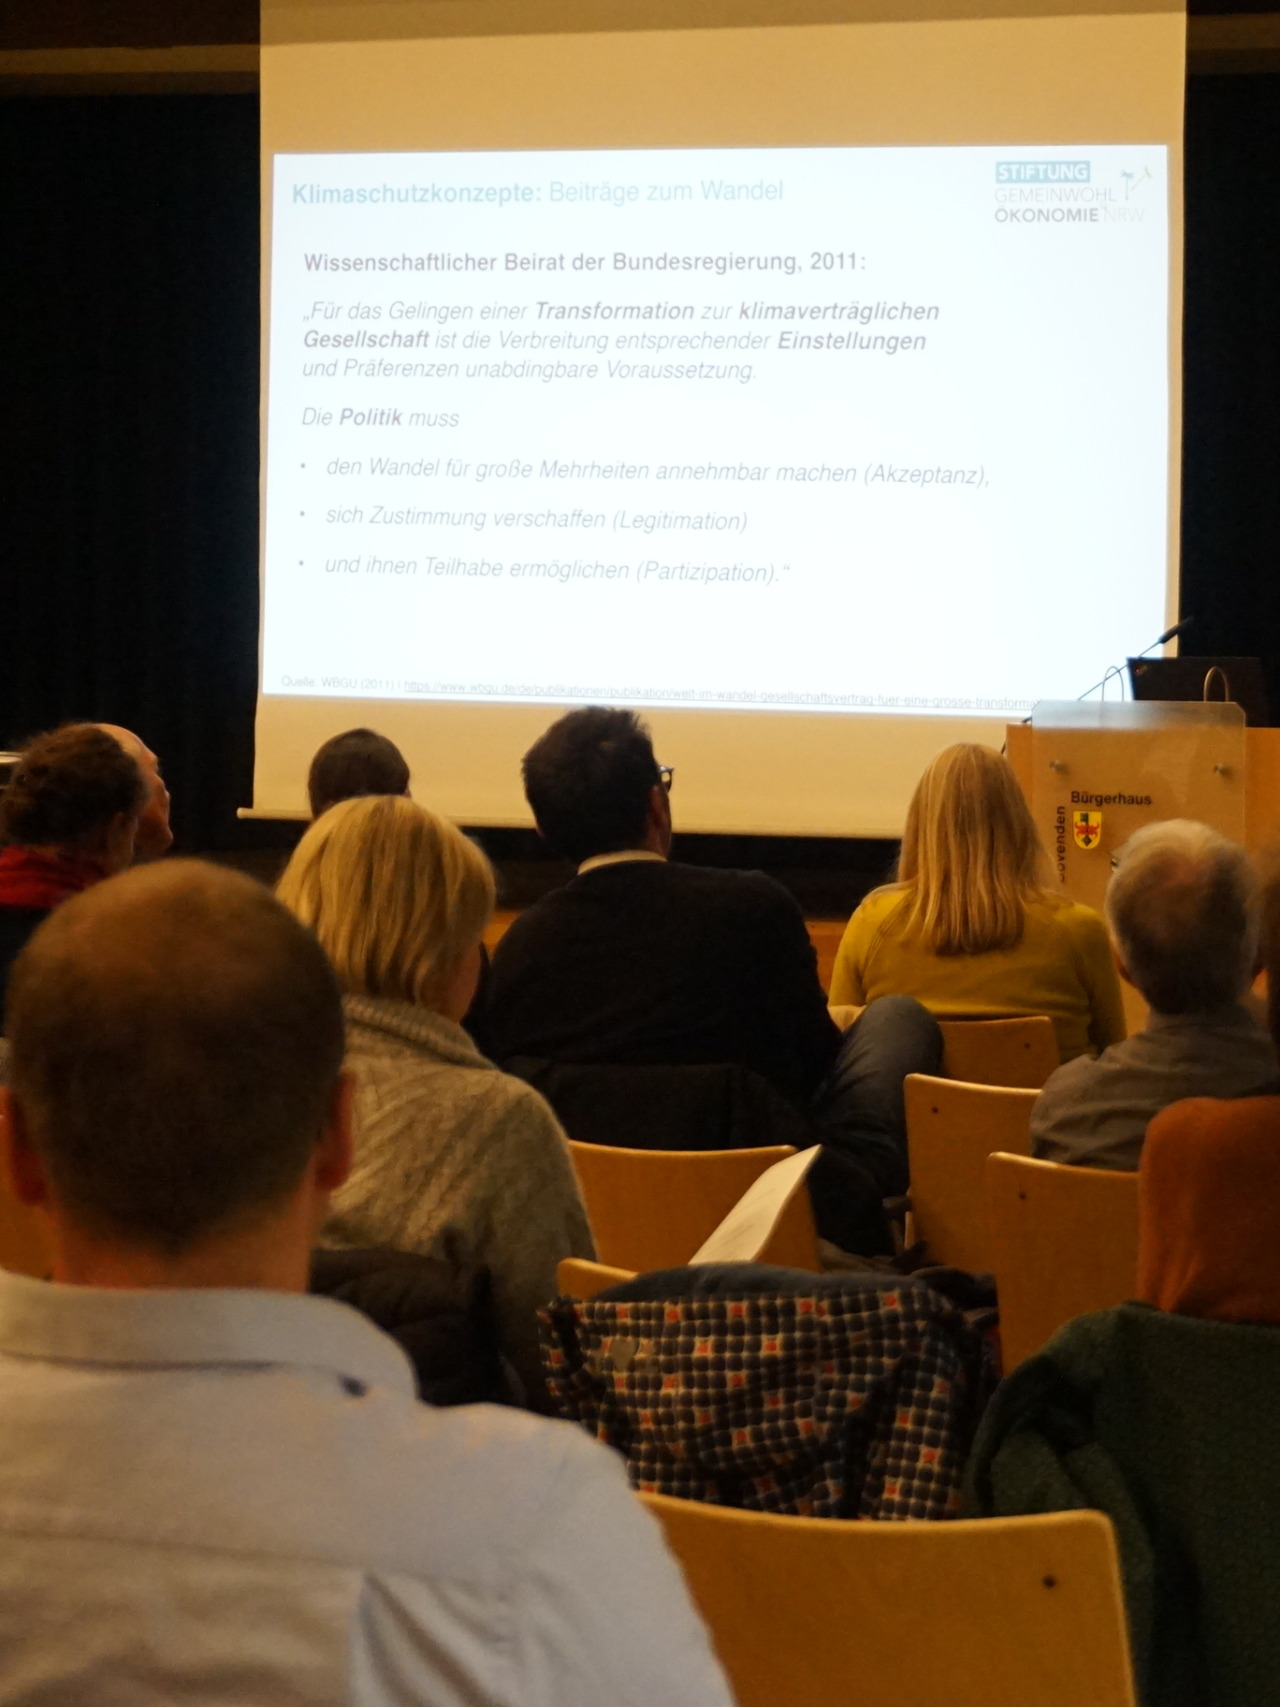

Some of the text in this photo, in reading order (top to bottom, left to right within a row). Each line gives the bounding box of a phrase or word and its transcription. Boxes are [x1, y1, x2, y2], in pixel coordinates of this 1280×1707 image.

[998, 163, 1089, 180] STIFTUNG
[292, 178, 784, 209] Klimaschutzkonzepte: Beiträge zum Wandel
[994, 186, 1118, 203] GEMEINWOHL
[994, 204, 1145, 223] ÖKONOMIE NRW
[303, 251, 866, 276] Wissenschaftlicher Beirat der Bundesregierung, 2011:
[302, 300, 940, 326] „Für das Gelingen einer Transformation zur klimaverträglichen
[303, 329, 927, 356] Gesellschaft ist die Verbreitung entsprechender Einstellungen
[302, 357, 757, 385] und Präferenzen unabdingbare Voraussetzung.
[301, 406, 460, 428] Die Politik muss
[326, 456, 990, 489] den Wandel für große Mehrheiten annehmbar machen (Akzeptanz),
[325, 504, 748, 535] sich Zustimmung verschaffen (Legitimation)
[324, 555, 362, 574] und
[365, 555, 418, 575] ihnen
[425, 556, 504, 577] Teilhabe
[509, 559, 630, 584] ermöglichen
[321, 676, 358, 689] WBGU
[361, 679, 394, 691] (2011)
[1070, 790, 1153, 808] Bürgerhaus
